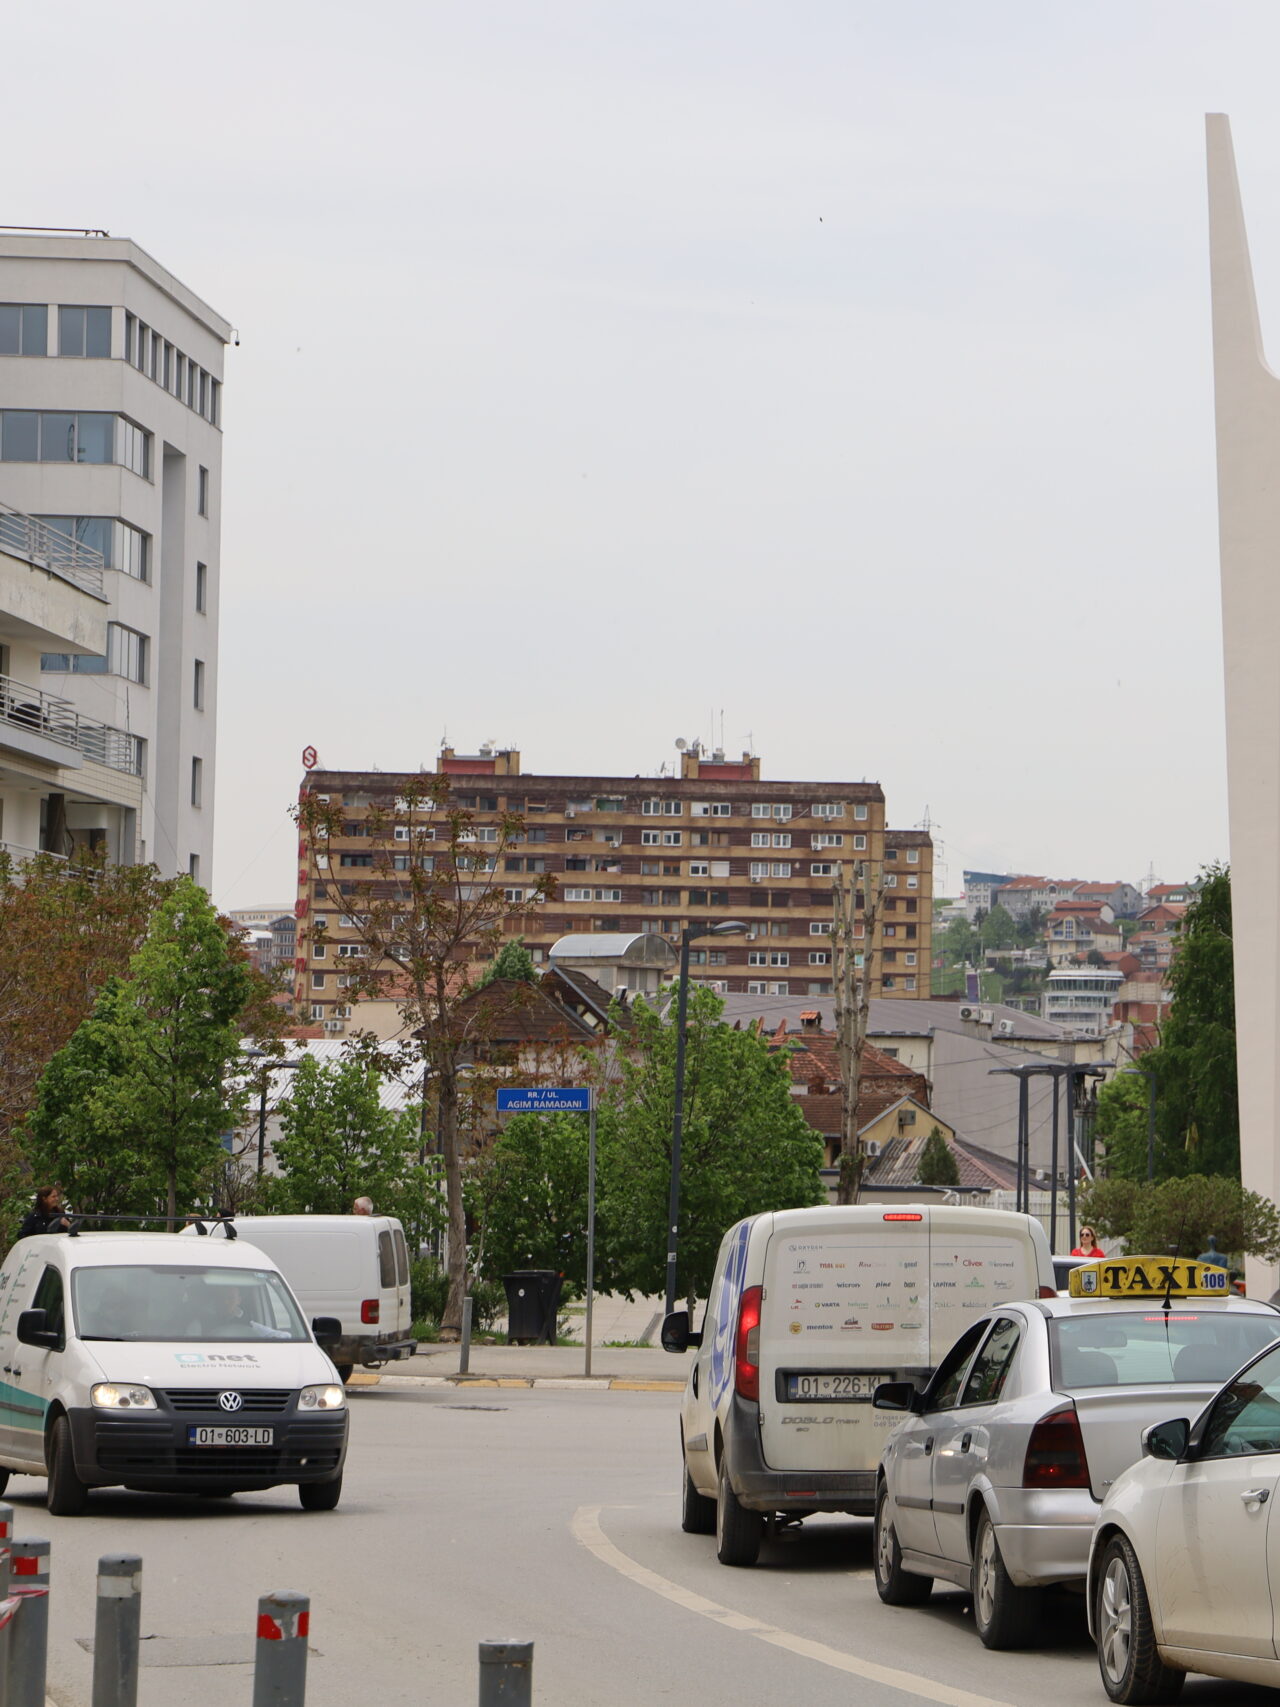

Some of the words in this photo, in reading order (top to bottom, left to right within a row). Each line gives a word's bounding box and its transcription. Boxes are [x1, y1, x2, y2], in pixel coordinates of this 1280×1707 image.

[527, 1091, 540, 1099] RR.
[547, 1091, 559, 1099] UL.
[507, 1100, 531, 1109] AGIM
[533, 1100, 582, 1109] RAMADANI
[1104, 1265, 1198, 1290] TAXI
[1203, 1273, 1225, 1289] 108
[801, 1377, 819, 1394] 01
[199, 1428, 215, 1444] 01
